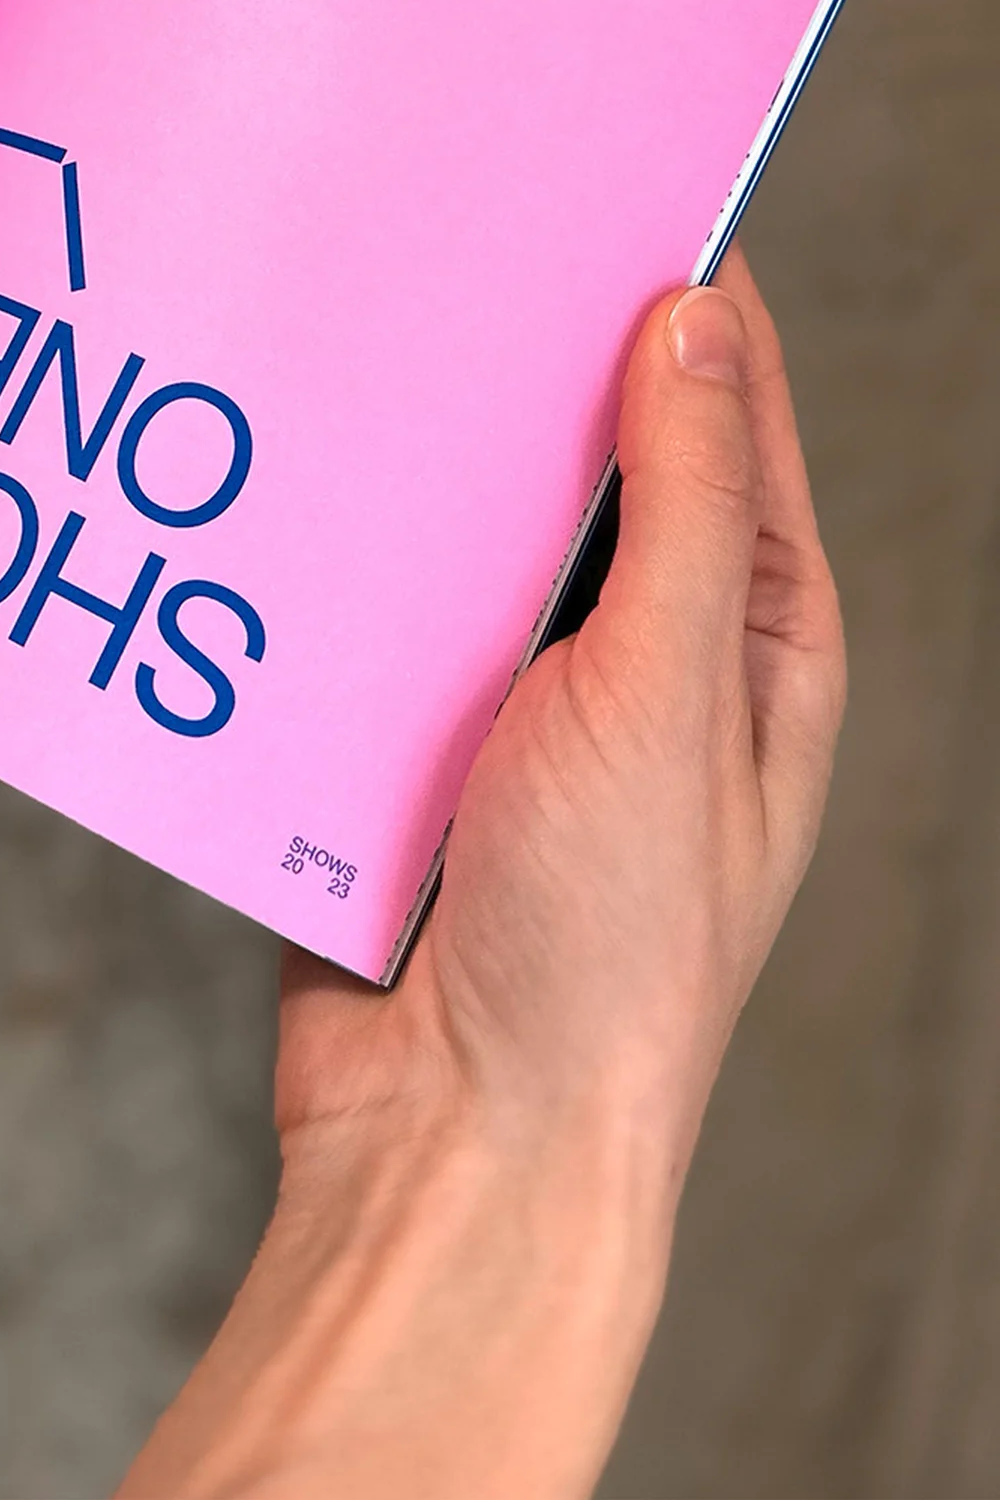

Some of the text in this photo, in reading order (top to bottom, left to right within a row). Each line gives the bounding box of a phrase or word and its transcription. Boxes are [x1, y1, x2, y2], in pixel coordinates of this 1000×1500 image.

[281, 853, 350, 899] 20 23
[289, 836, 358, 883] SHOWS
